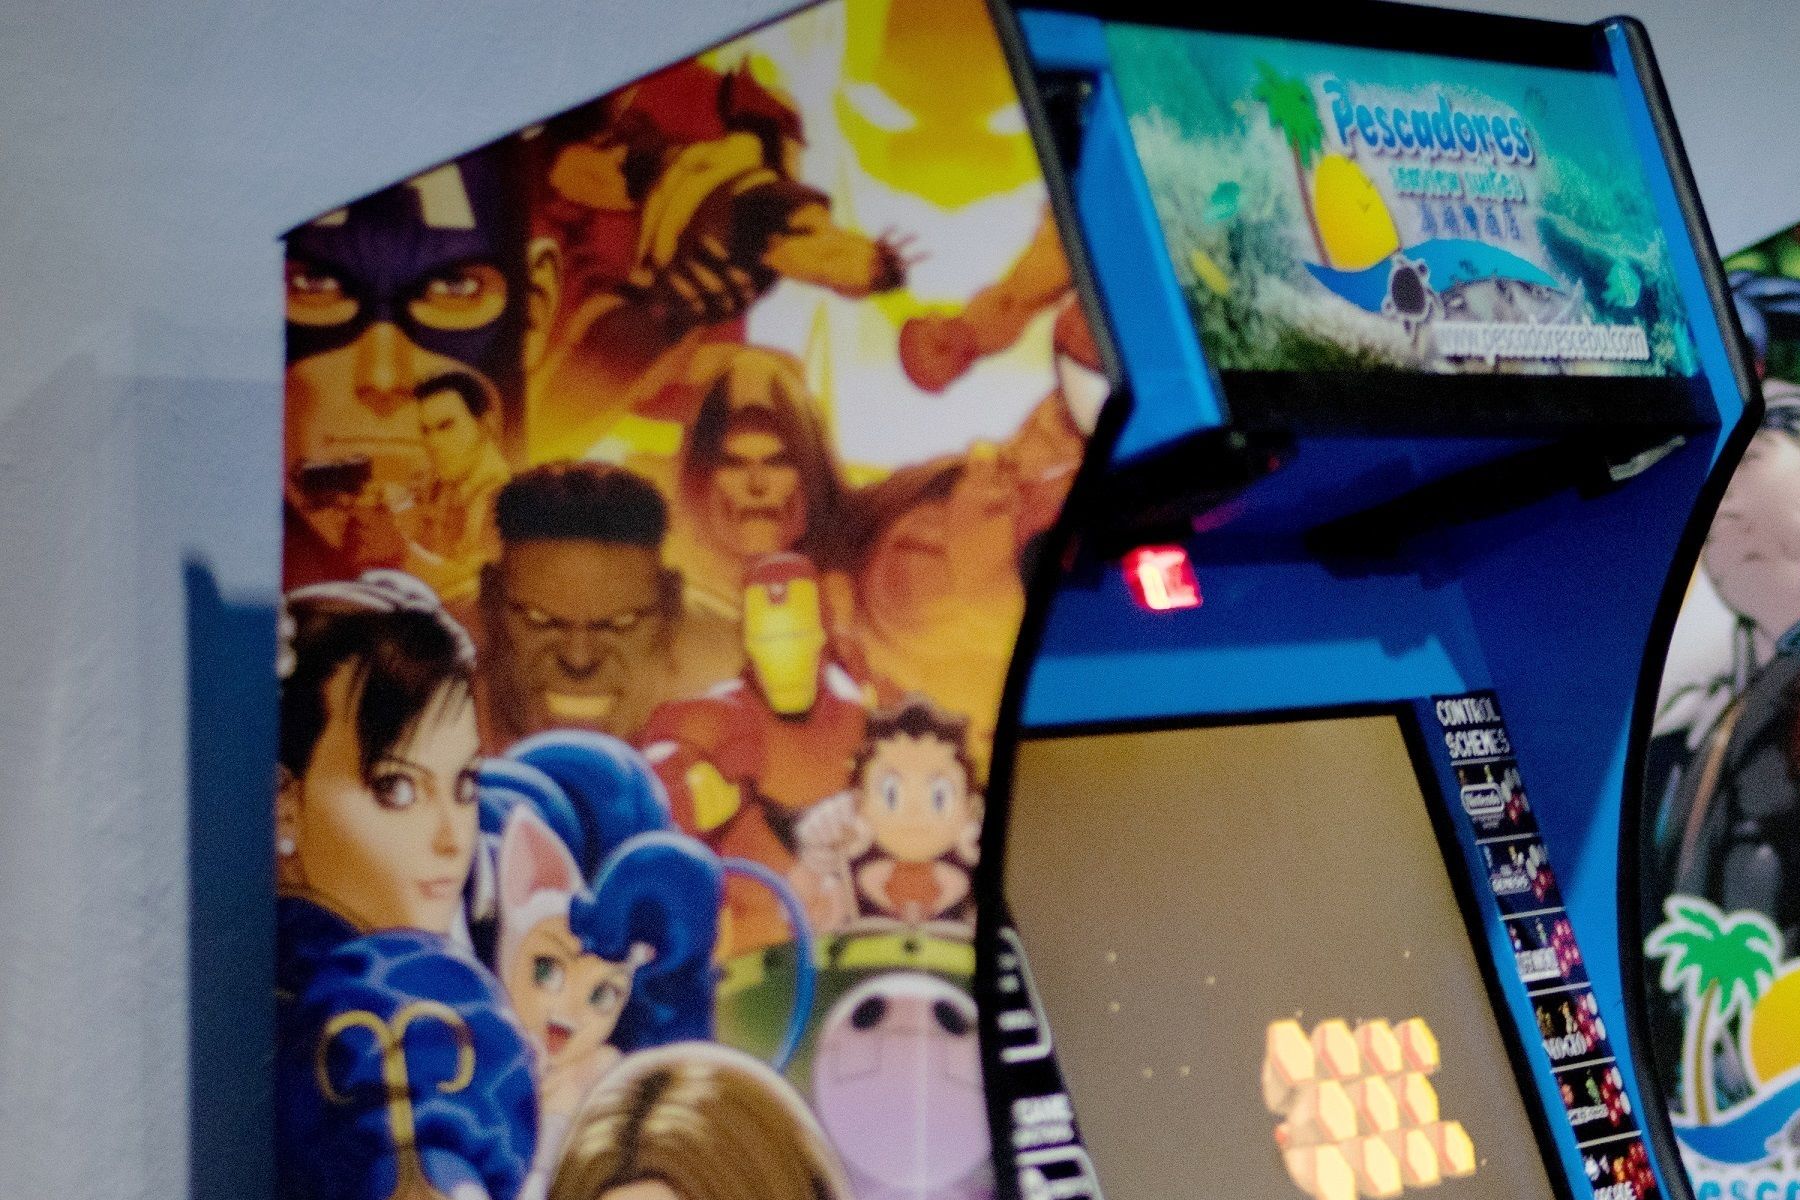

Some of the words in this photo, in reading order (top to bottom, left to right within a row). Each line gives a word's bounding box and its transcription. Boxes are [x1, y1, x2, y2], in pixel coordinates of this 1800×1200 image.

[1323, 79, 1531, 158] Pescadores
[1436, 697, 1501, 726] CONTROL
[1445, 728, 1510, 759] SCHEMES
